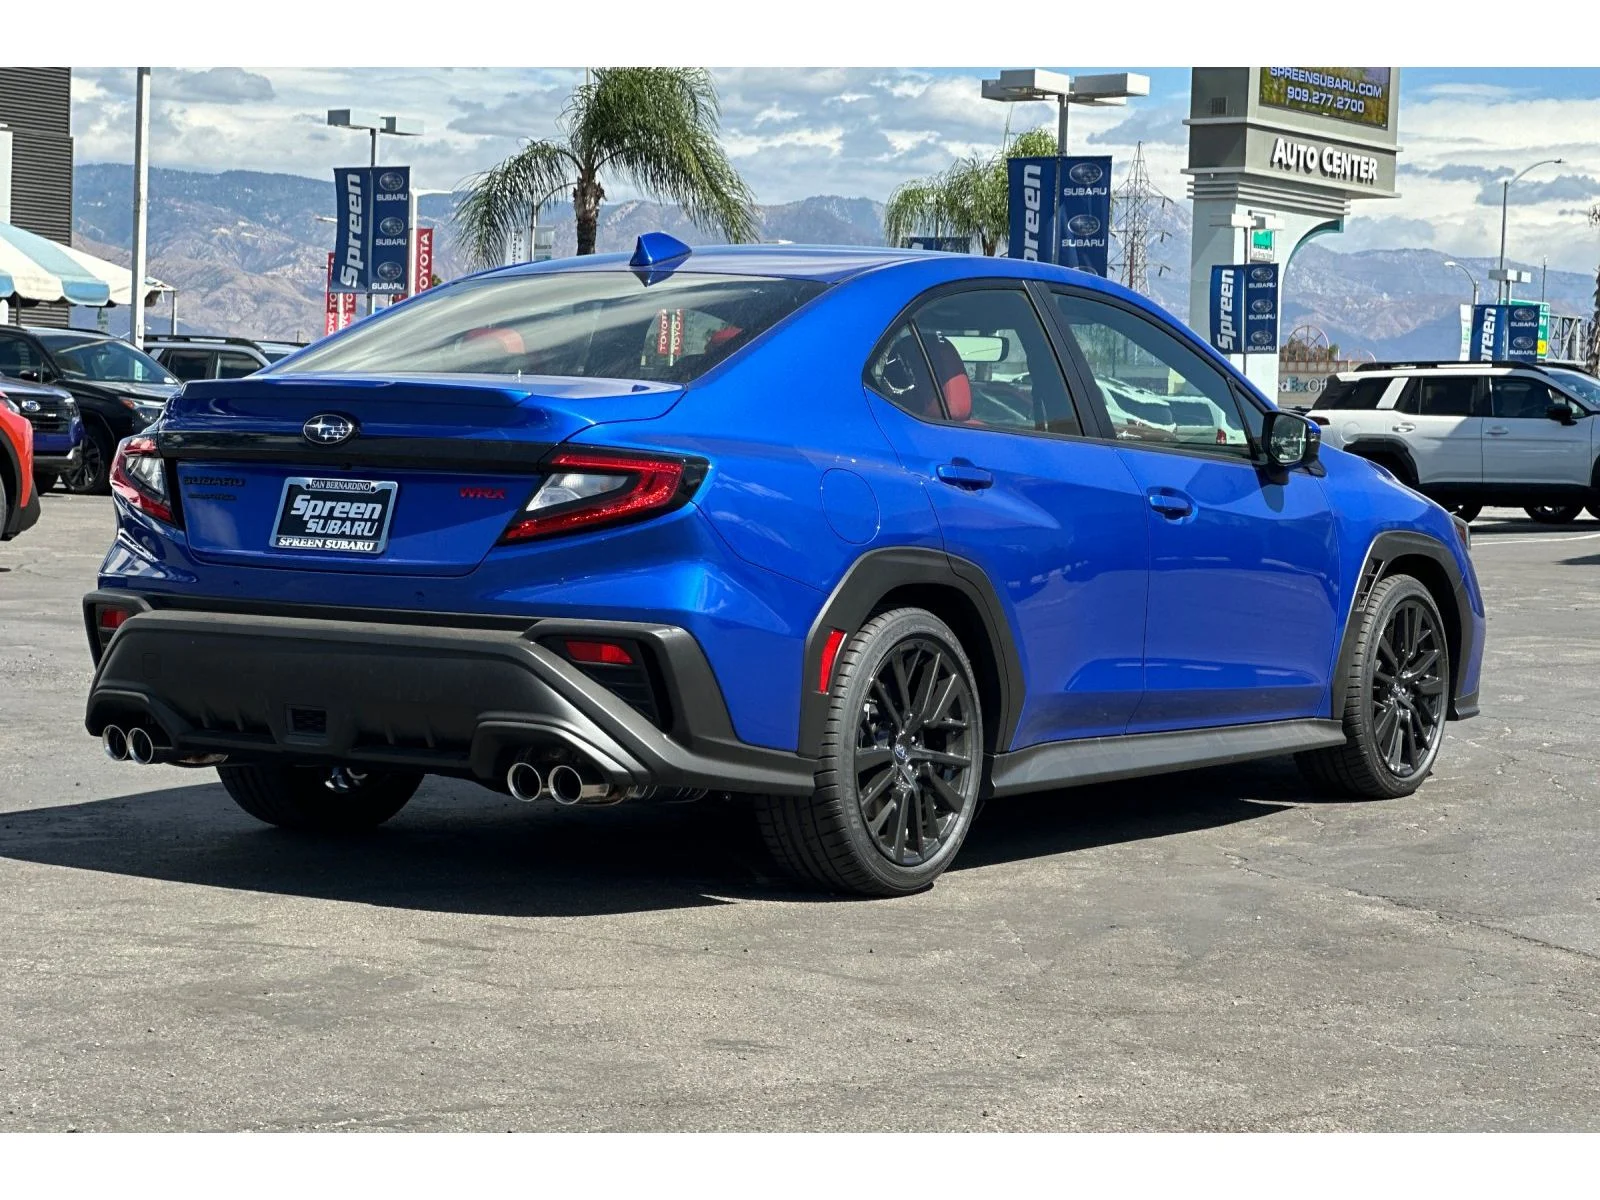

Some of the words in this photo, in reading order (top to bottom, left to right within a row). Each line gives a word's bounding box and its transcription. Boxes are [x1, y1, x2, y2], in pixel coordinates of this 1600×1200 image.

[1270, 67, 1382, 98] SPREENSUBARU.COM
[1287, 86, 1365, 113] 909.277.2700
[1272, 137, 1319, 170] AUTO
[1322, 146, 1378, 180] CENTER
[1063, 187, 1107, 196] SUBARU
[1023, 164, 1041, 262] reen
[340, 174, 364, 288] Spreen
[1061, 239, 1105, 247] SUBARU
[418, 232, 430, 293] OYOTA
[371, 282, 405, 290] SUBARU
[1217, 269, 1237, 351] Spreen
[1481, 308, 1497, 363] reen
[1279, 375, 1308, 393] dEx
[311, 480, 325, 489] SAN
[325, 481, 370, 491] BERNARDINO
[460, 487, 505, 499] WRX
[290, 494, 383, 521] Spreen
[305, 518, 379, 537] SUBARU
[278, 537, 323, 548] SPREEN
[325, 540, 375, 551] SUBARU
